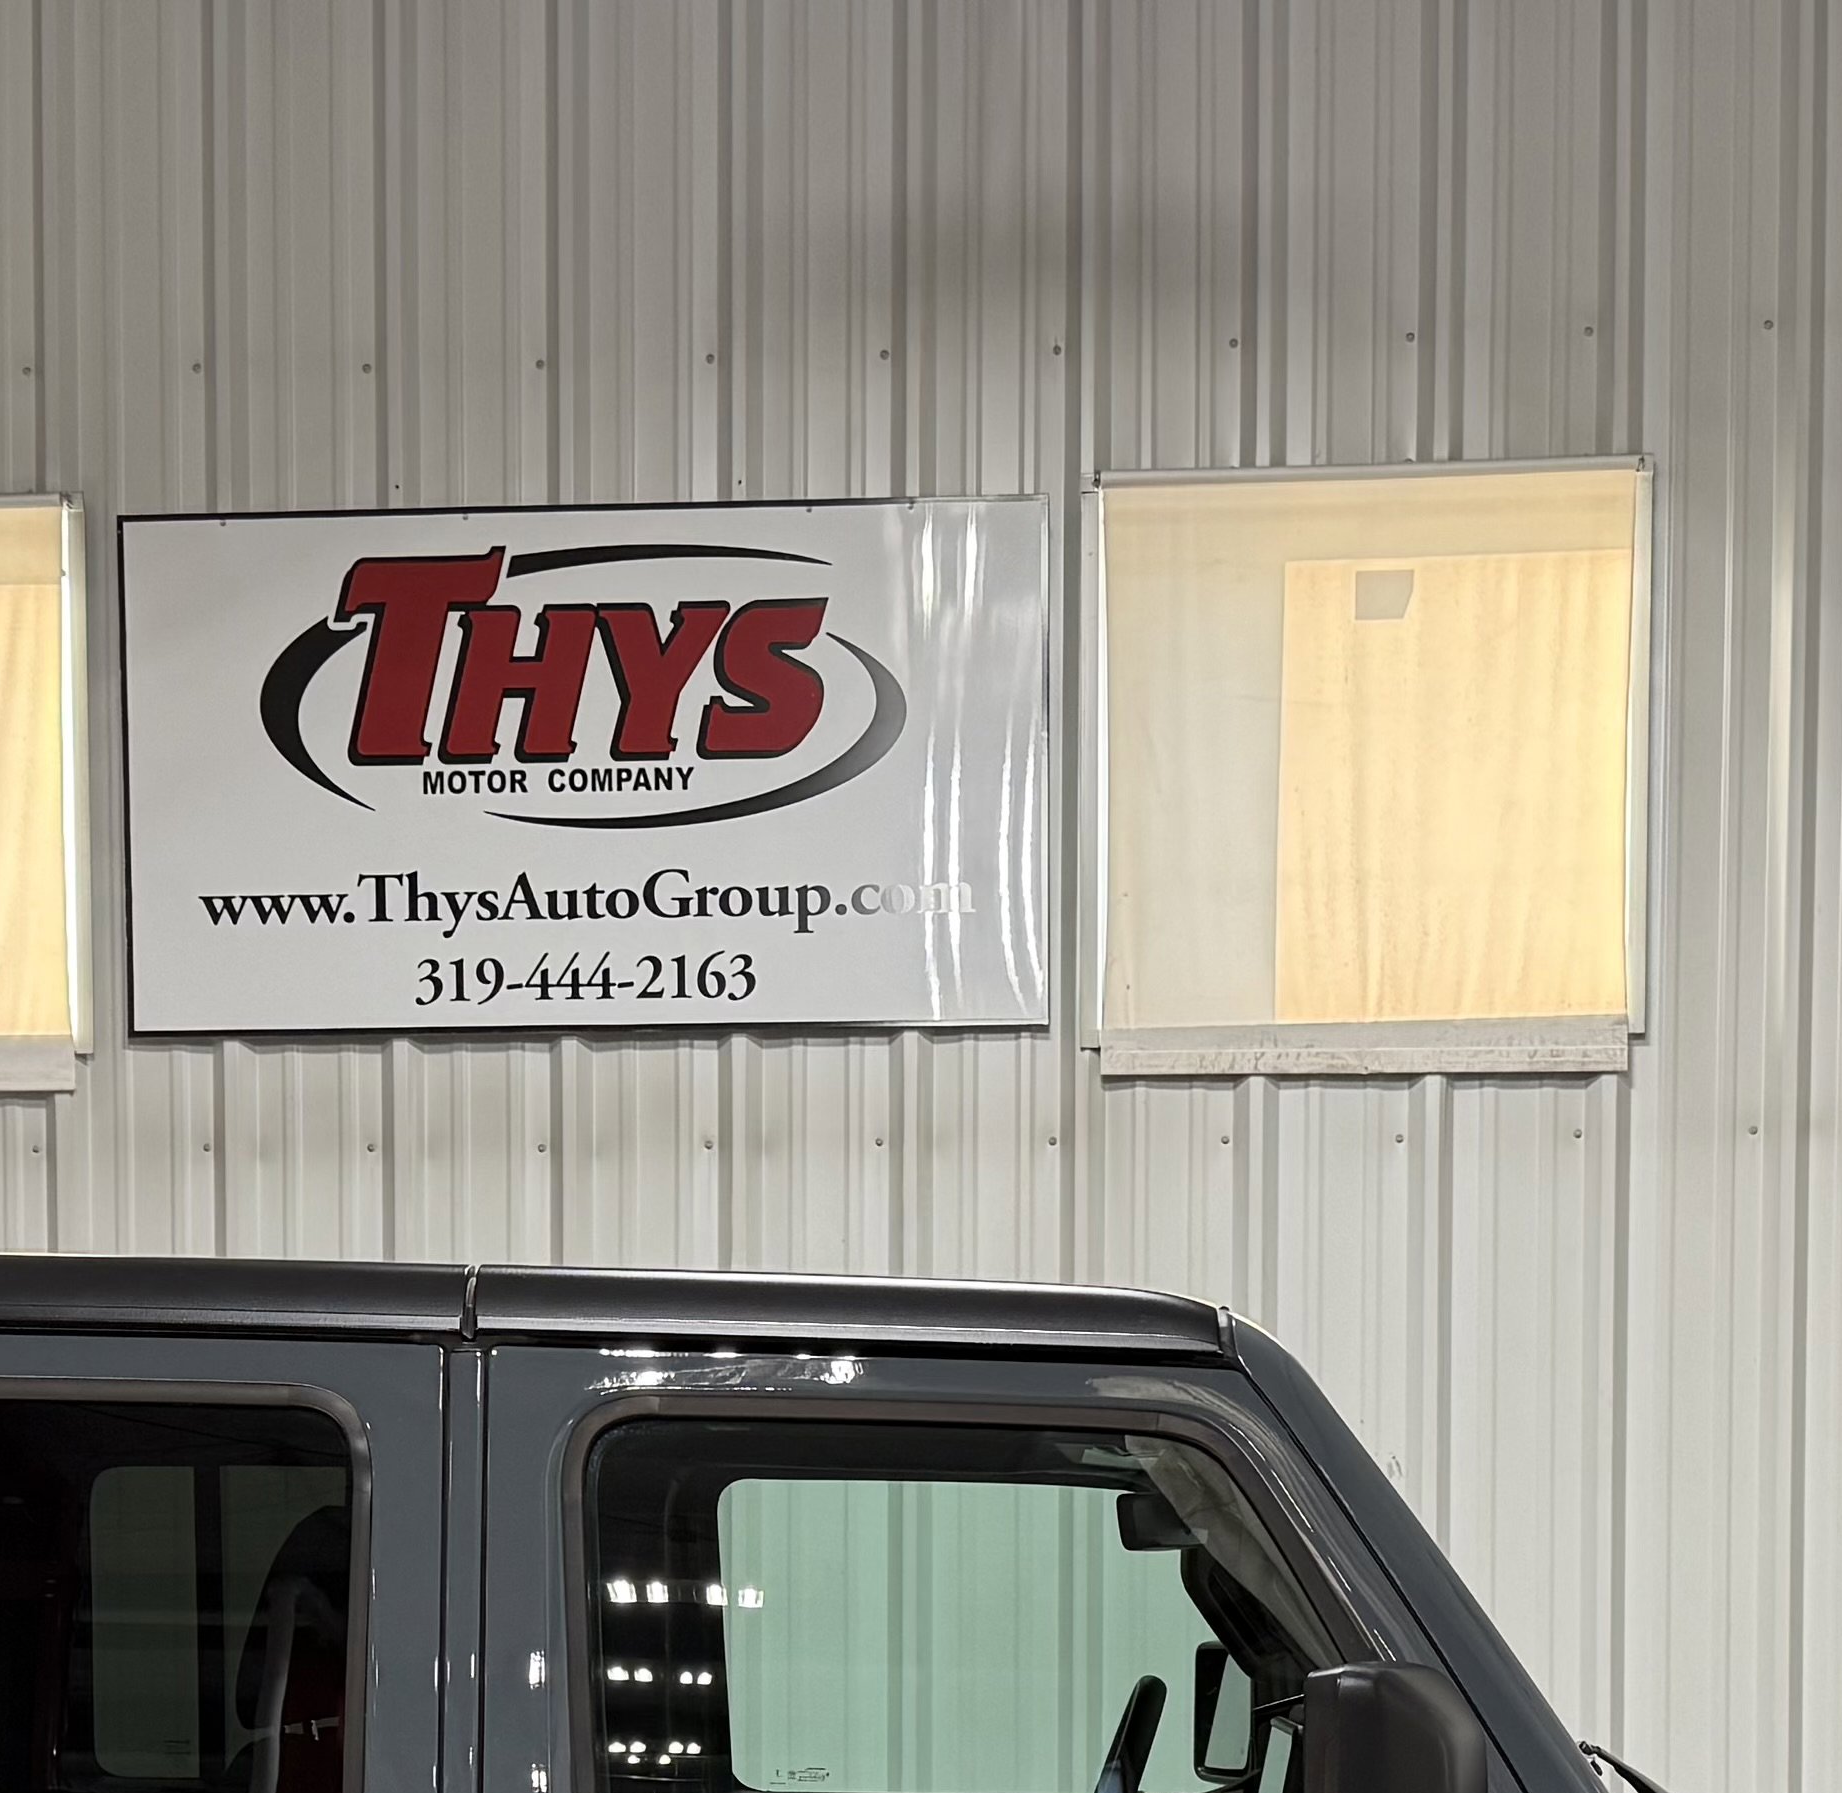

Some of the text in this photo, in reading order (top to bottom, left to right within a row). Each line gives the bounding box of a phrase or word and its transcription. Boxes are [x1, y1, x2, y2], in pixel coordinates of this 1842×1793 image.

[422, 766, 695, 795] MOTOR COMPANY
[198, 868, 976, 939] www.ThysAutoGroup.com
[415, 950, 757, 1006] 319-444-2163
